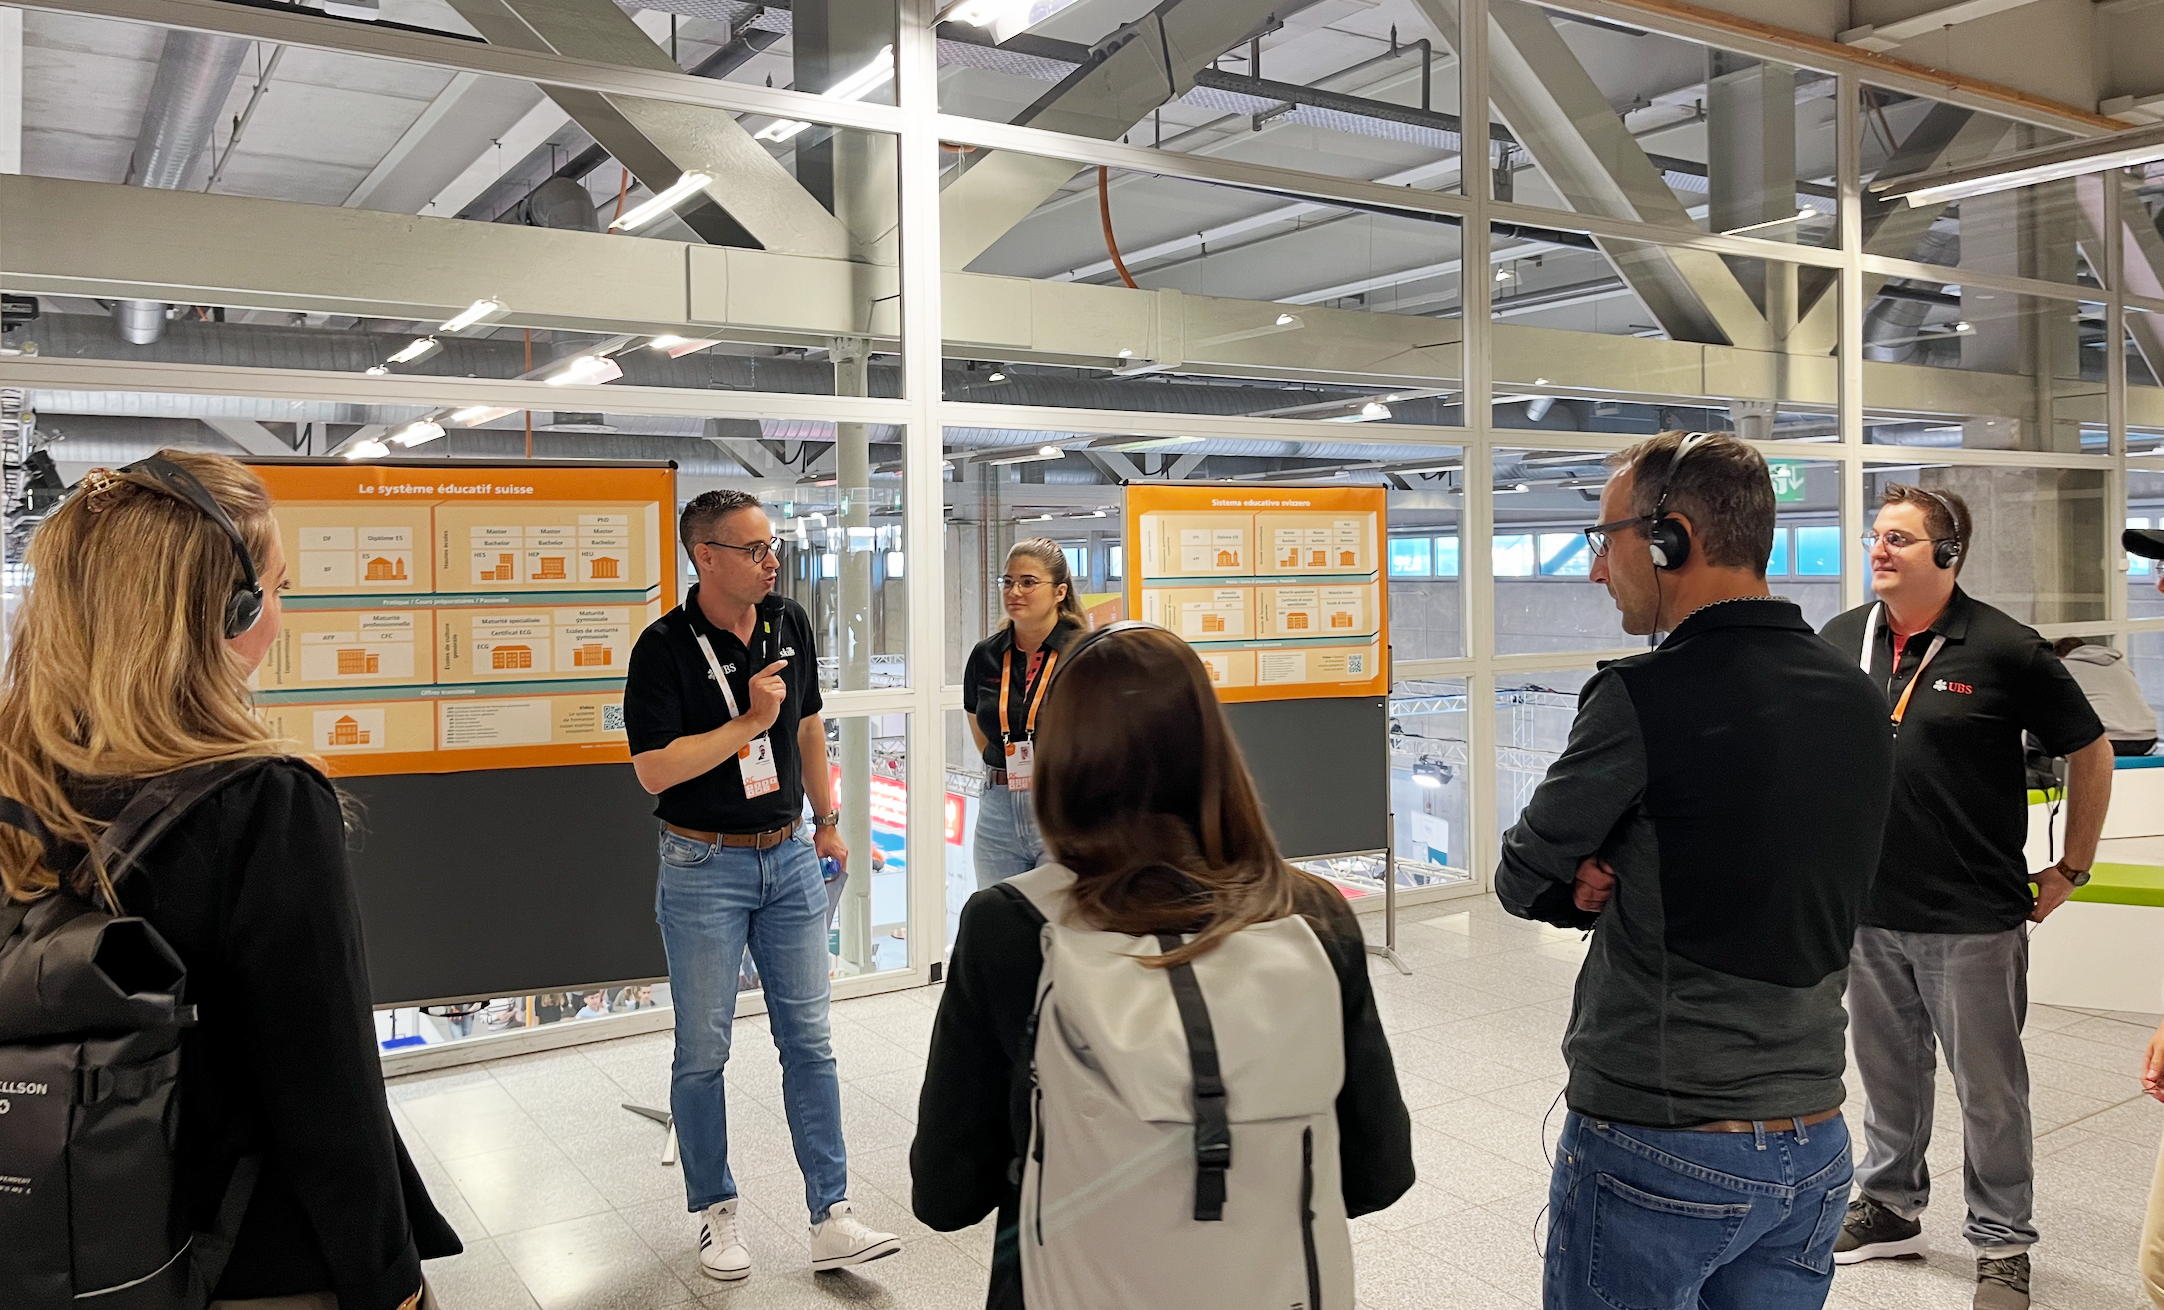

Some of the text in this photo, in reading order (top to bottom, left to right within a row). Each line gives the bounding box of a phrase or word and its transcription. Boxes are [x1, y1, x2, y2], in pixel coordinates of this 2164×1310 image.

[358, 483, 534, 496] Le système éducatif suisse
[1211, 499, 1311, 507] Sistema educativo svizzero
[1948, 681, 1974, 695] UBS
